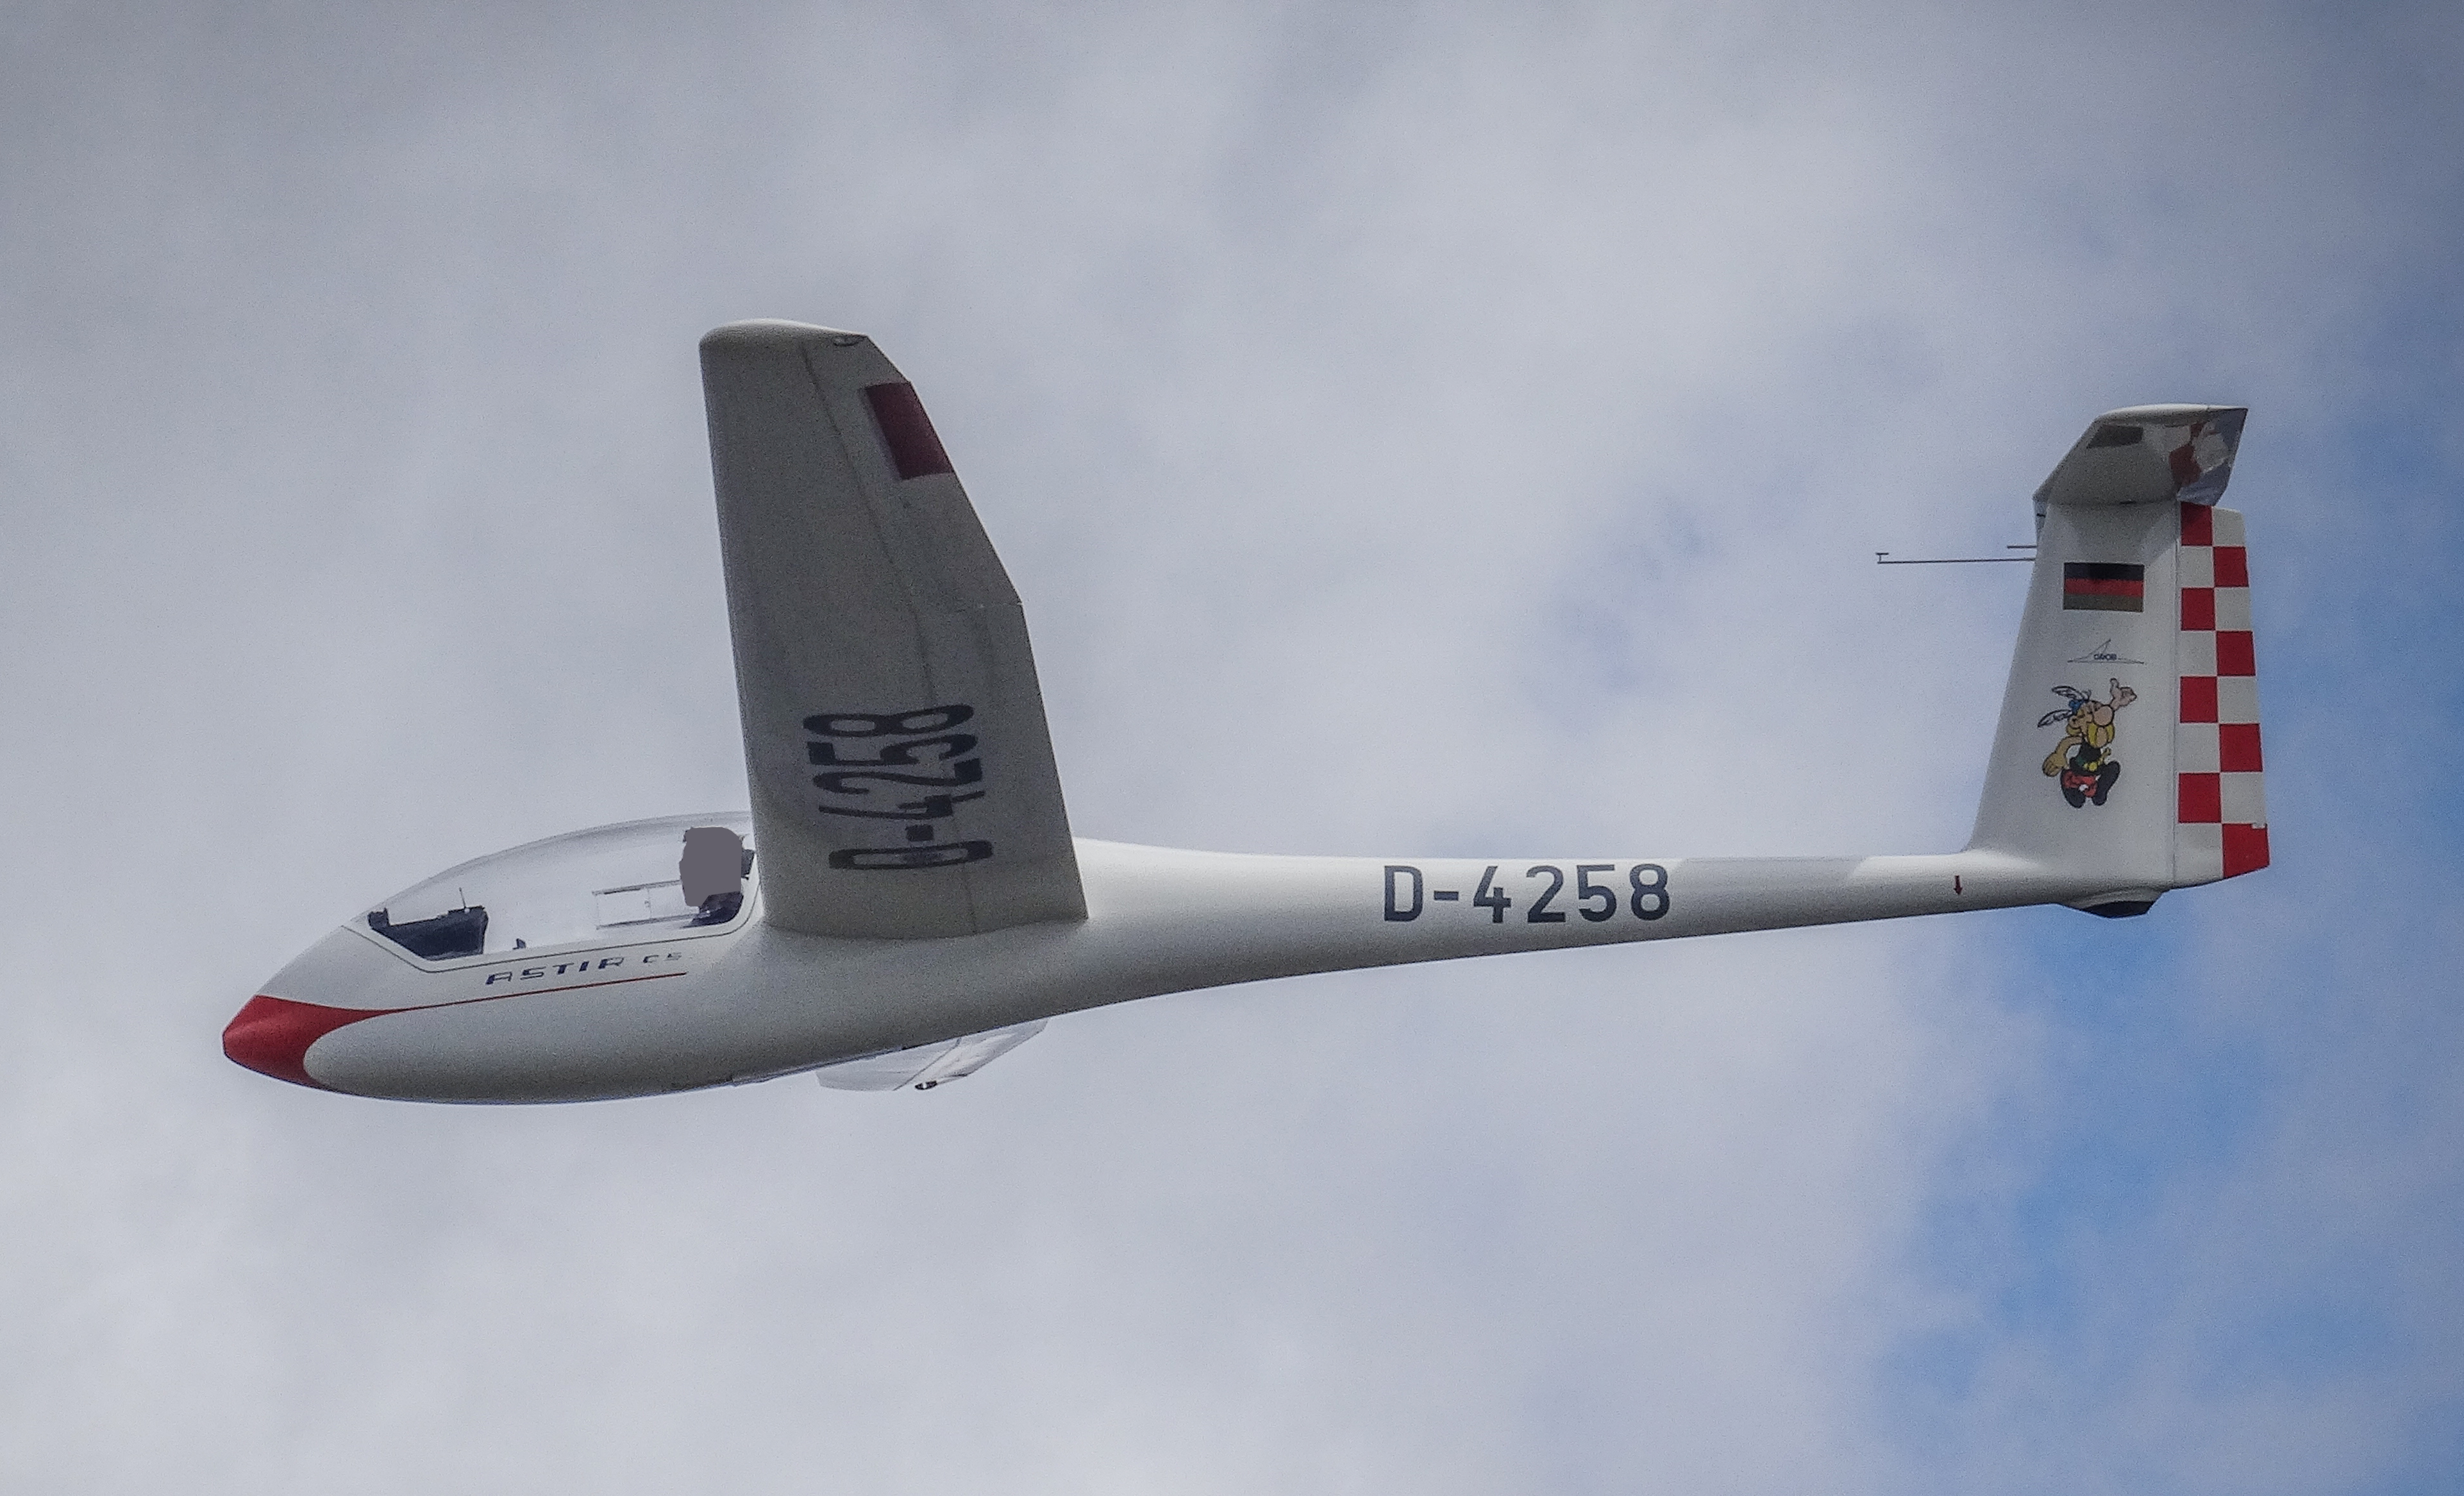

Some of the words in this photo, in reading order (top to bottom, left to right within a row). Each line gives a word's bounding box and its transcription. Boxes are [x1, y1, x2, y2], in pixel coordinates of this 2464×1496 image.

[803, 705, 993, 870] D-4258
[1384, 863, 1670, 924] D-4258
[485, 957, 624, 985] ASTIR
